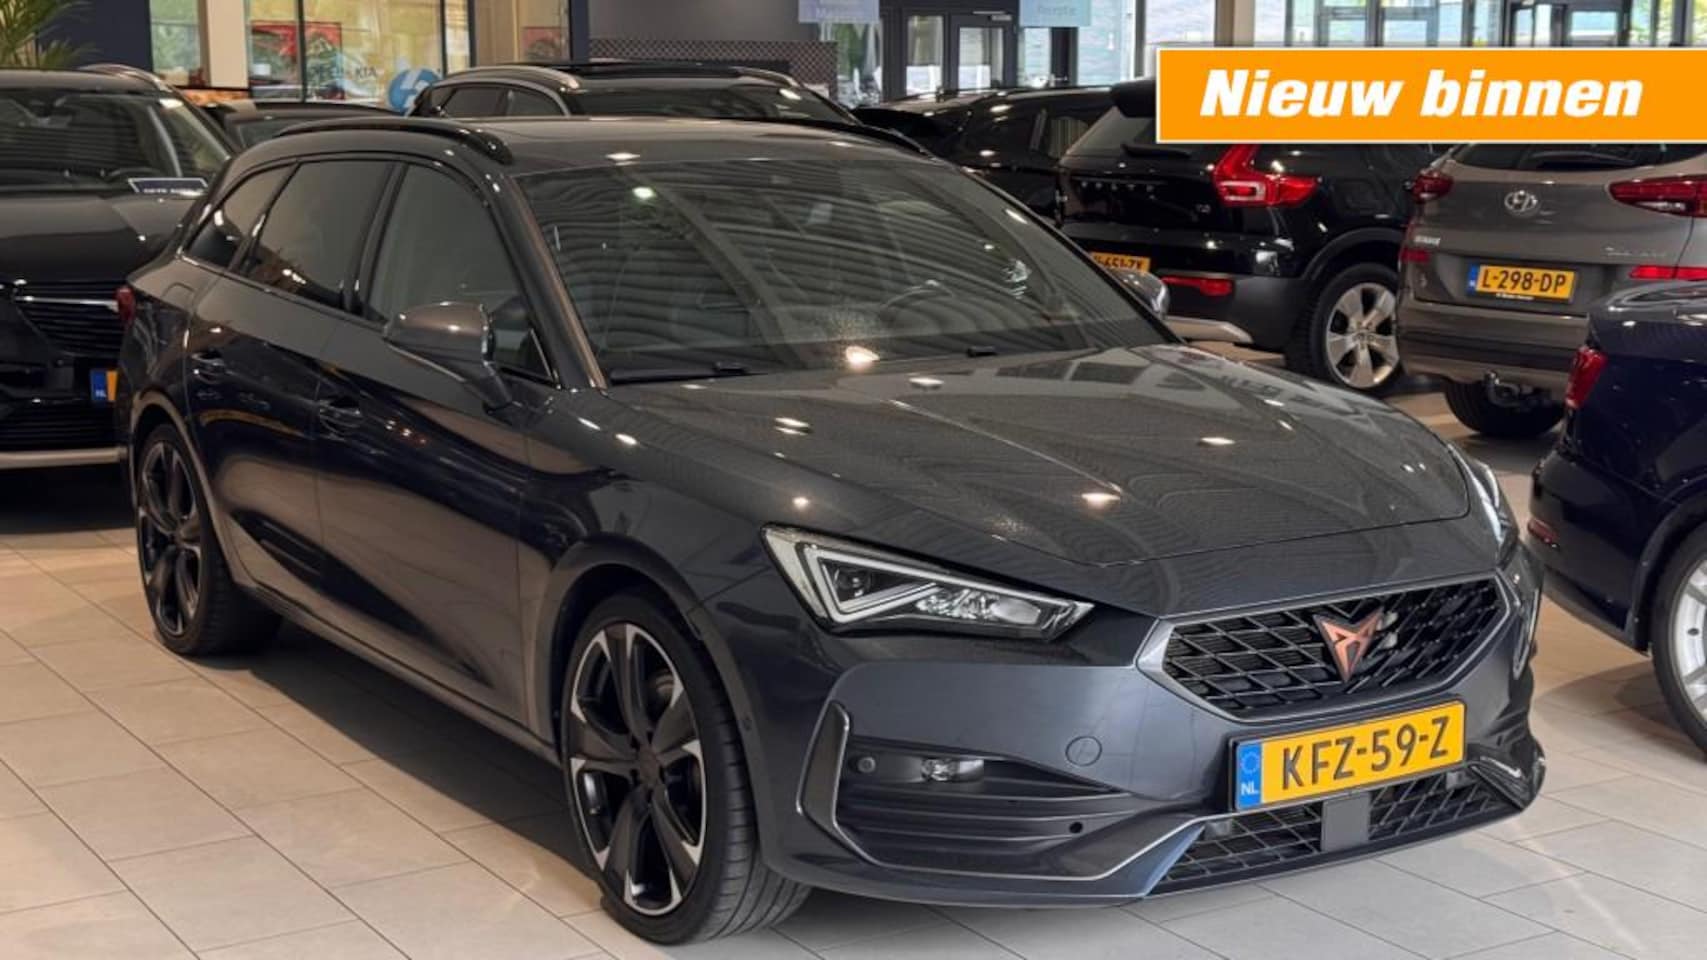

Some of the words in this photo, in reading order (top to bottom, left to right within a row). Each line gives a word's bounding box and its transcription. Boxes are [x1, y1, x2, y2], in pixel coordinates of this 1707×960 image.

[1481, 268, 1567, 293] L-298-DP
[1282, 715, 1450, 791] KFZ-59-Z
[1240, 780, 1259, 796] NL
